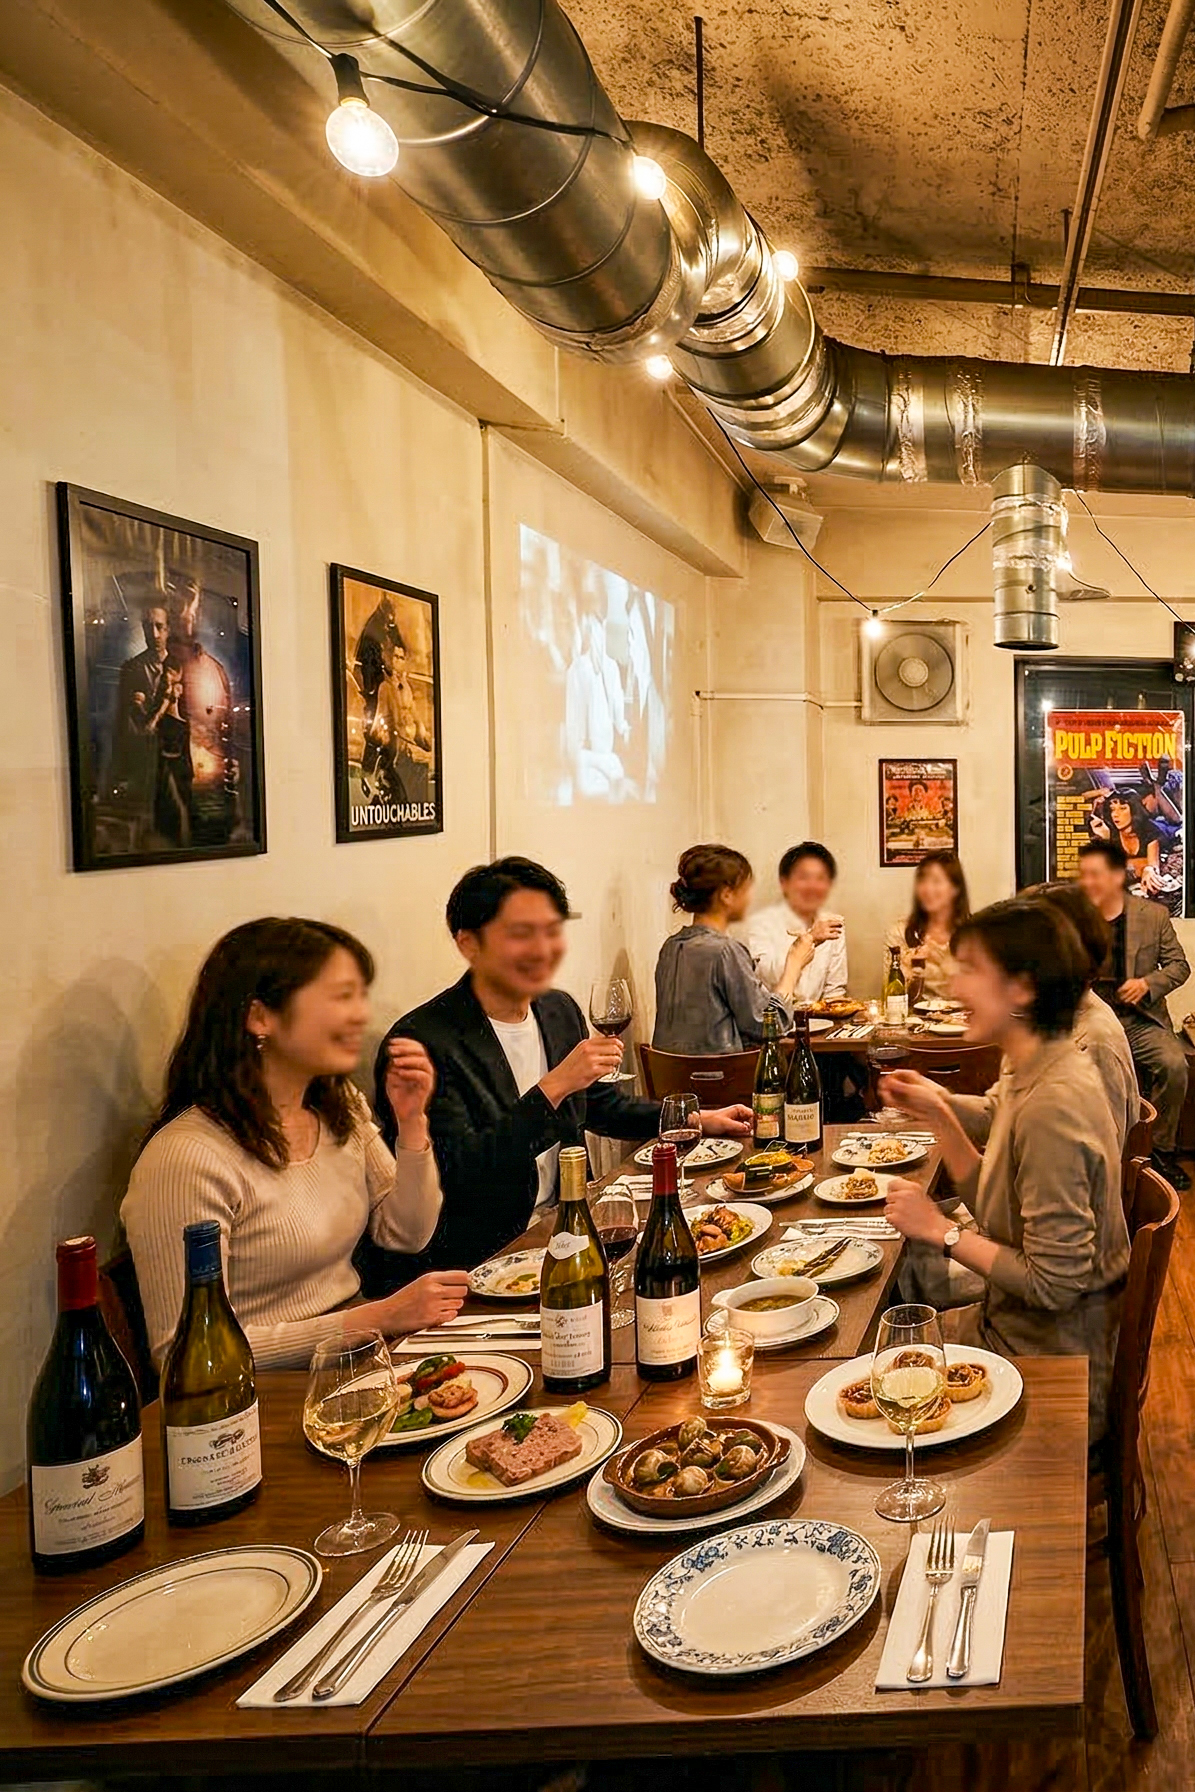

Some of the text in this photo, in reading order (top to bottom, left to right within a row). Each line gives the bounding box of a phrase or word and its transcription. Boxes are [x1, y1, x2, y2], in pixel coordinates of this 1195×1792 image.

[1055, 729, 1177, 760] PULP FICTION
[351, 802, 436, 826] UNTOUCHABLES
